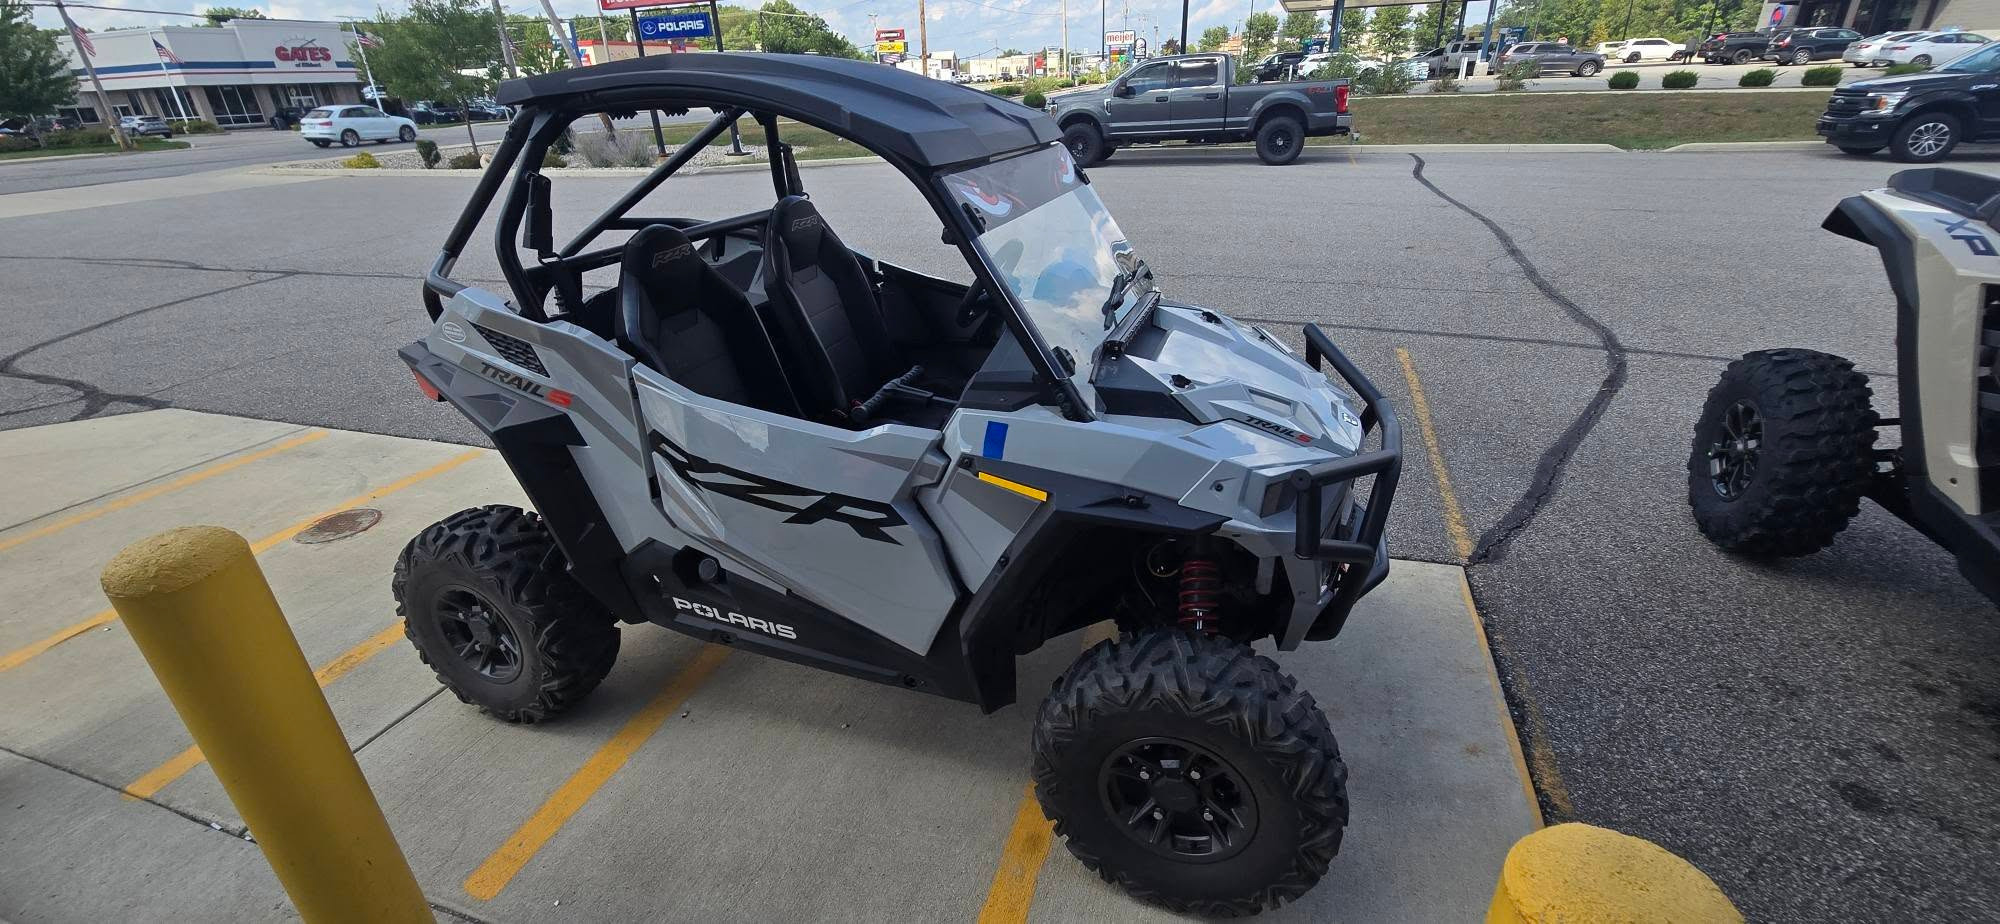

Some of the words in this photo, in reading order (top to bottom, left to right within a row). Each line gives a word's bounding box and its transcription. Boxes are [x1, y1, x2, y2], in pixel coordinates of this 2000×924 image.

[658, 20, 705, 32] POLARIS
[1106, 32, 1134, 43] meijer
[274, 46, 332, 61] GATES
[792, 214, 820, 231] RZR
[1933, 218, 2000, 256] XP
[652, 242, 692, 268] RZR
[480, 361, 545, 398] TRAIL
[547, 389, 573, 407] S
[1246, 415, 1295, 437] TRAIL
[1296, 434, 1312, 442] S
[648, 428, 909, 546] RZR
[672, 596, 797, 640] POLARIS
